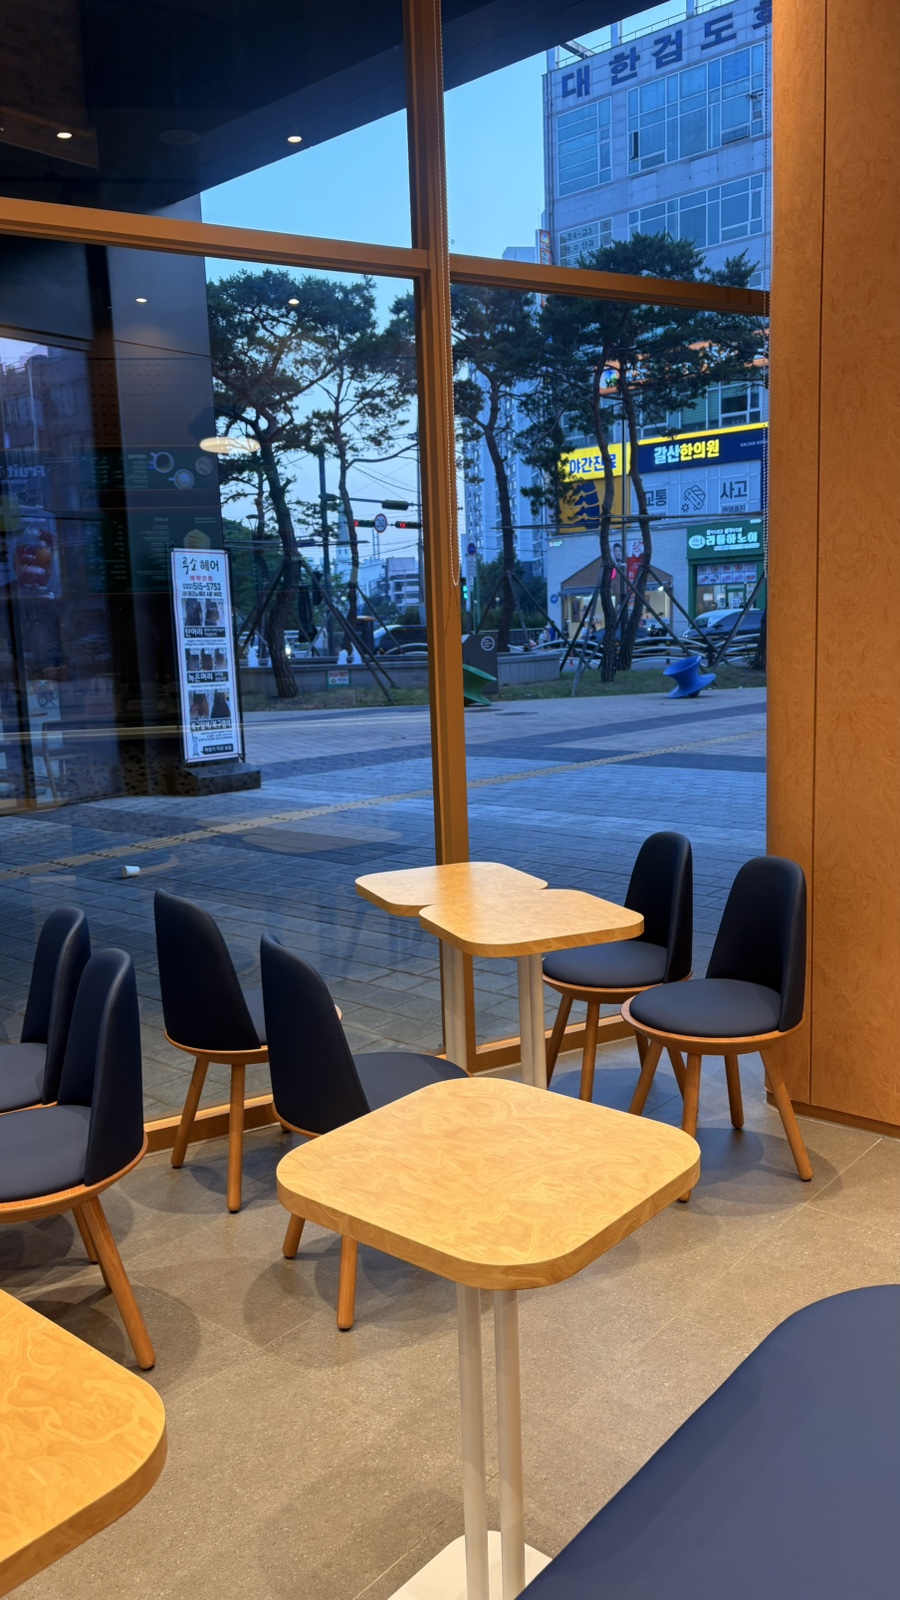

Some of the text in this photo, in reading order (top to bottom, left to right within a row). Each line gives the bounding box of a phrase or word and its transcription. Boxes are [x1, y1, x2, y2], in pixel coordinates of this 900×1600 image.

[654, 439, 719, 464] 갈산한의원
[720, 480, 748, 499] 사고
[199, 559, 219, 572] 헤어
